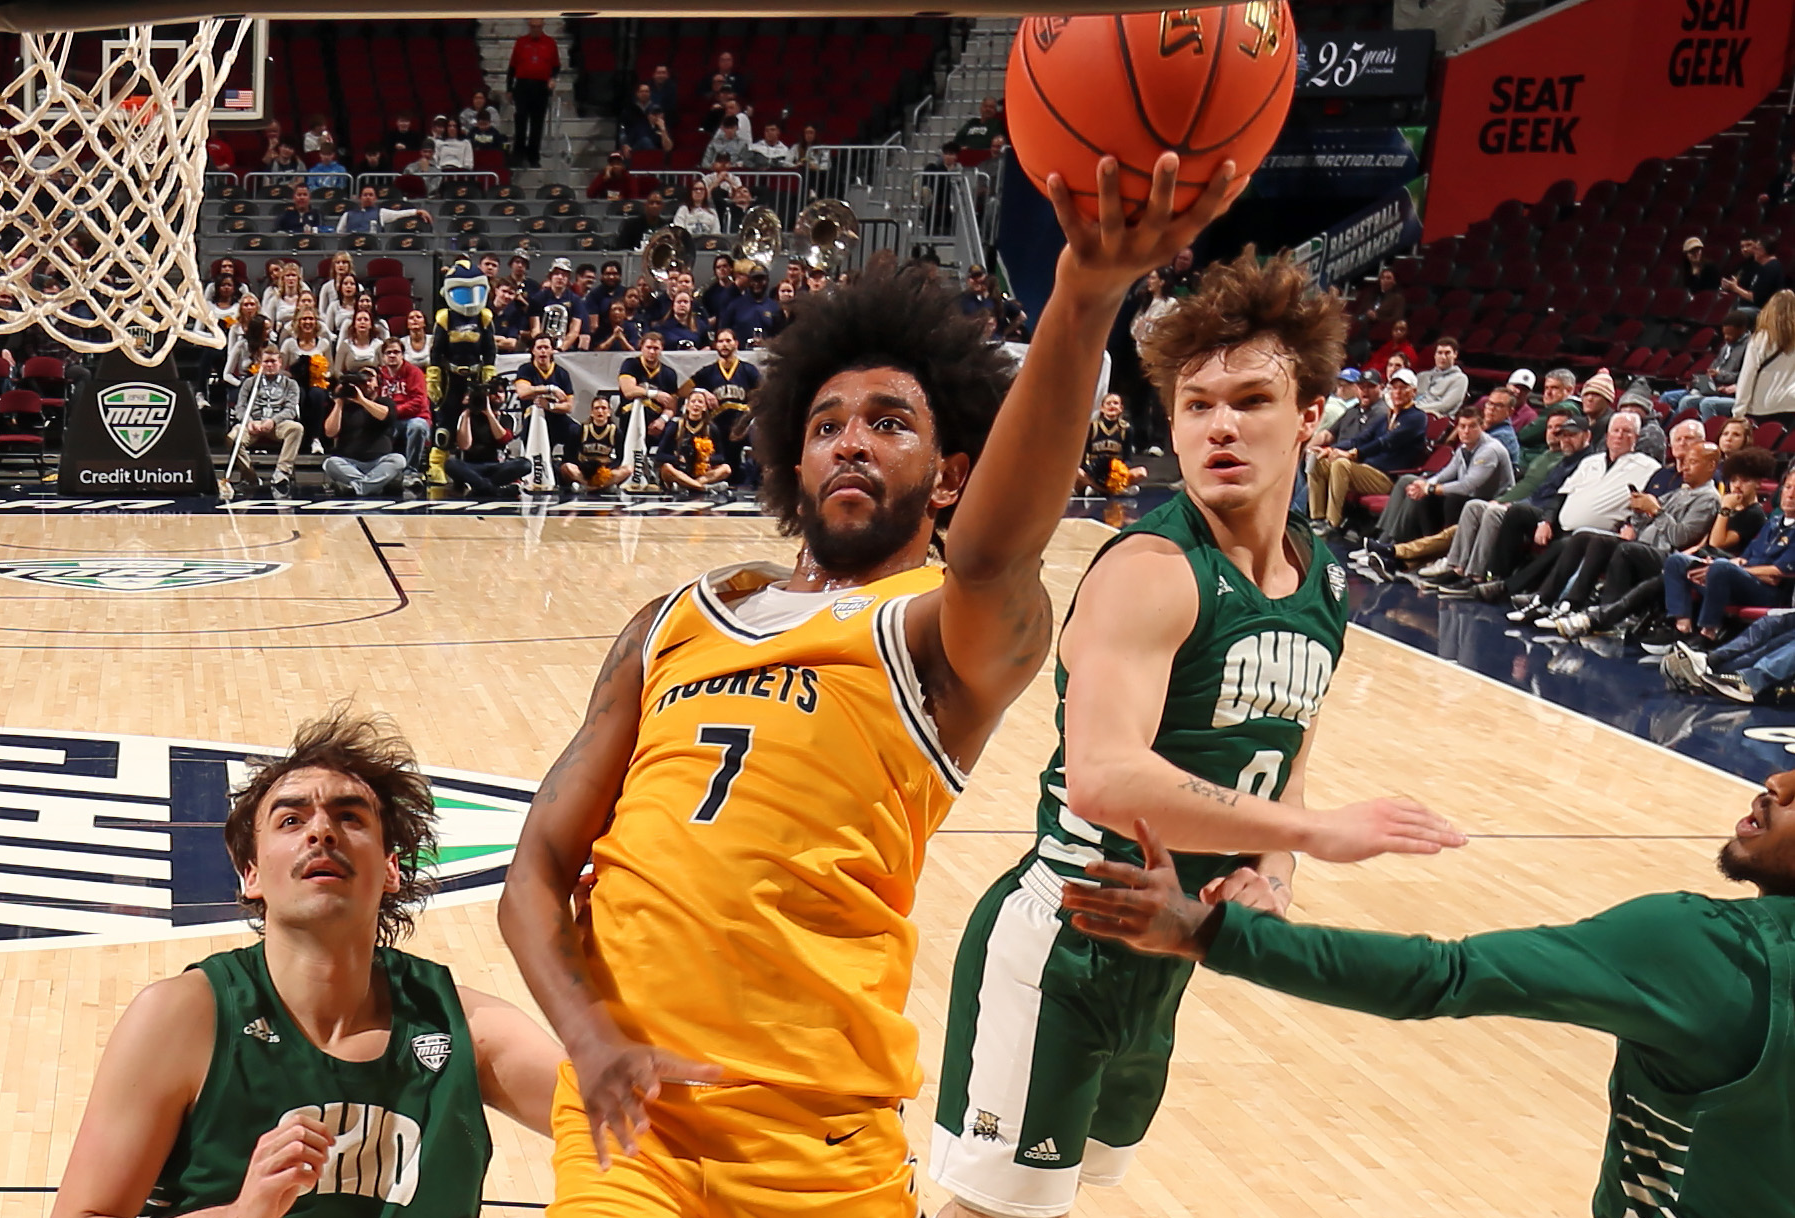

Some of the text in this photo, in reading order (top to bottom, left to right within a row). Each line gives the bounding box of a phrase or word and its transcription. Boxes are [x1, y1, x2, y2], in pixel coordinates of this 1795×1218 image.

[1680, 0, 1751, 31] SEAT
[1307, 42, 1398, 87] 25 years
[1668, 37, 1751, 88] GEEK
[1489, 74, 1585, 114] SEAT
[1478, 117, 1581, 155] GEEK
[1328, 200, 1402, 254] BASKETBALL
[1326, 221, 1404, 281] TOURNAMENT
[107, 407, 168, 426] MAC
[79, 469, 131, 484] Credit
[215, 500, 761, 511] CONFERE
[1211, 631, 1333, 731] OHIO
[688, 724, 755, 825] 7
[416, 1044, 452, 1056] MAC
[1024, 1150, 1061, 1161] adidas
